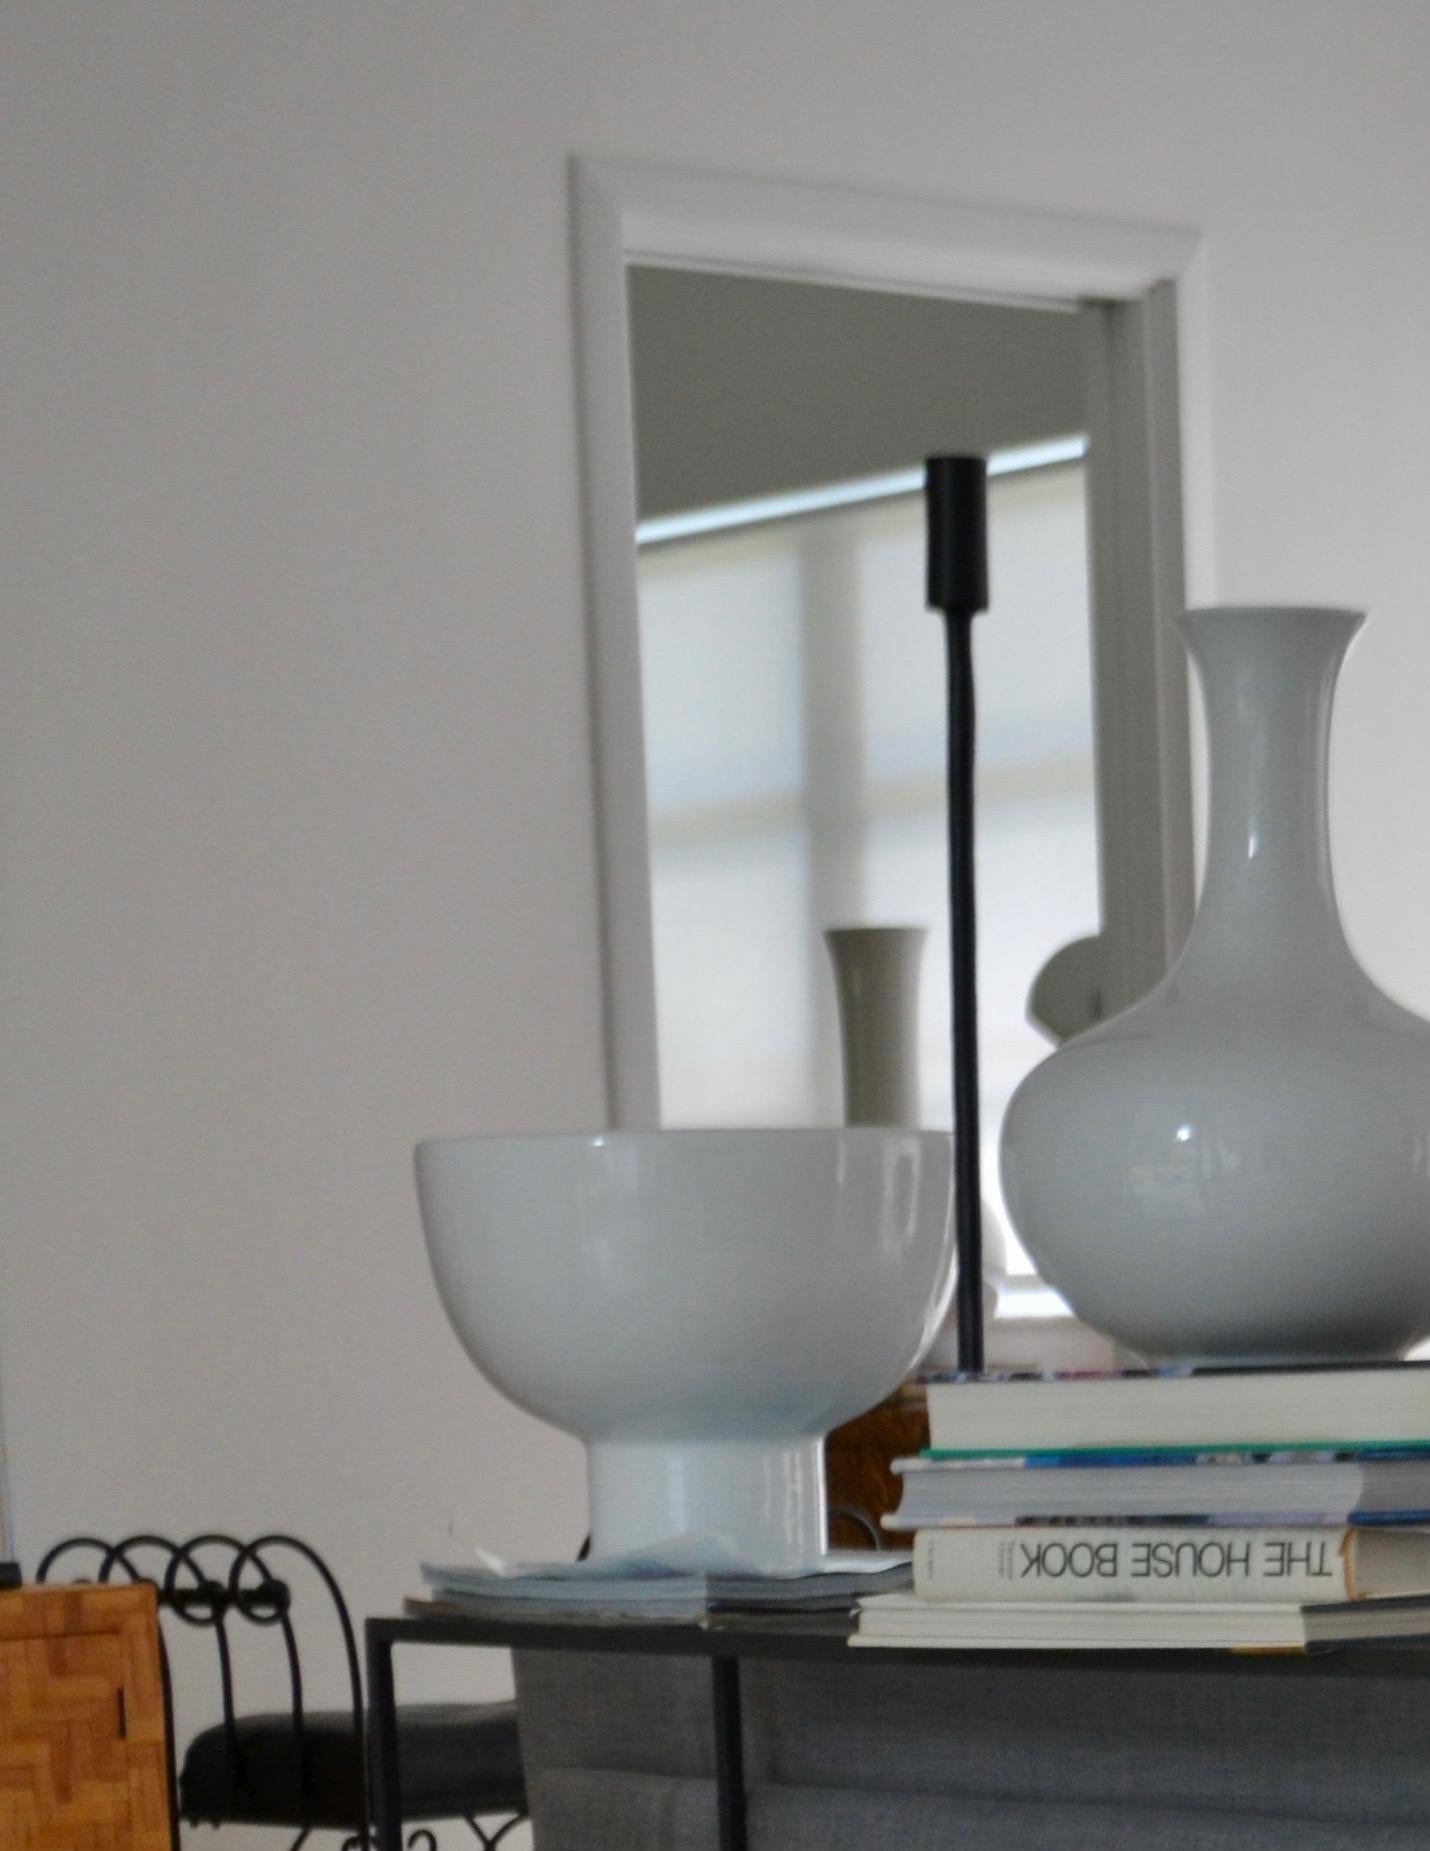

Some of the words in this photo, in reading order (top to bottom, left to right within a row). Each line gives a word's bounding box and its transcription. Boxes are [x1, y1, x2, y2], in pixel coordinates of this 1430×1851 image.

[1020, 1541, 1119, 1579] BOOK
[1131, 1541, 1250, 1579] HOUSE
[1263, 1541, 1333, 1578] THE
